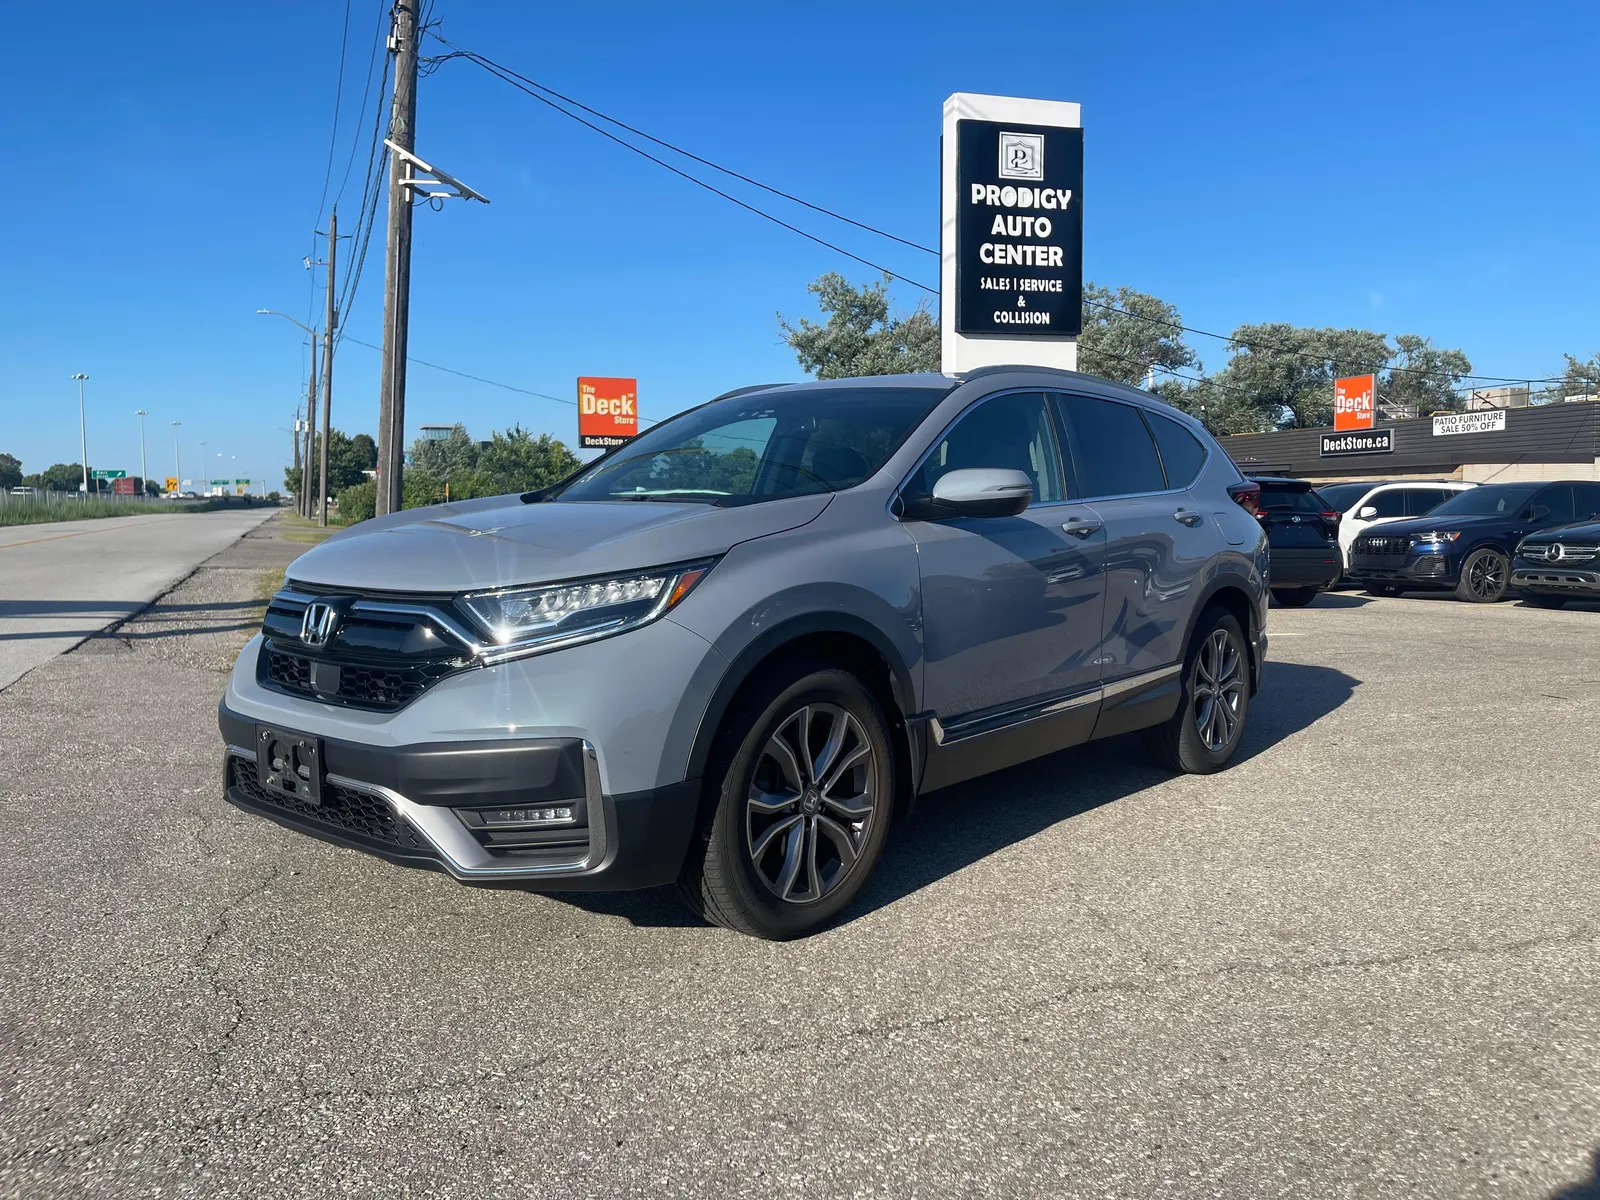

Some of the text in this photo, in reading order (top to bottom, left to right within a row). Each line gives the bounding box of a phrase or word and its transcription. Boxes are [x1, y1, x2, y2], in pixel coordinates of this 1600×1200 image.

[971, 183, 1072, 210] PRODIGY
[991, 214, 1052, 238] AUTO
[979, 242, 1063, 267] CENTER
[980, 277, 1010, 290] SALES
[1019, 278, 1063, 292] SERVICE
[1017, 295, 1026, 307] &
[993, 311, 1050, 324] COLLISION
[582, 385, 595, 393] The
[582, 394, 634, 415] Deck
[1336, 392, 1371, 414] Deck
[614, 416, 635, 425] Store
[1356, 412, 1371, 420] Store
[1434, 411, 1504, 426] PATIO FURNITURE
[1440, 420, 1496, 434] SALE 50% OFF
[1323, 436, 1389, 452] DeckStore.ca
